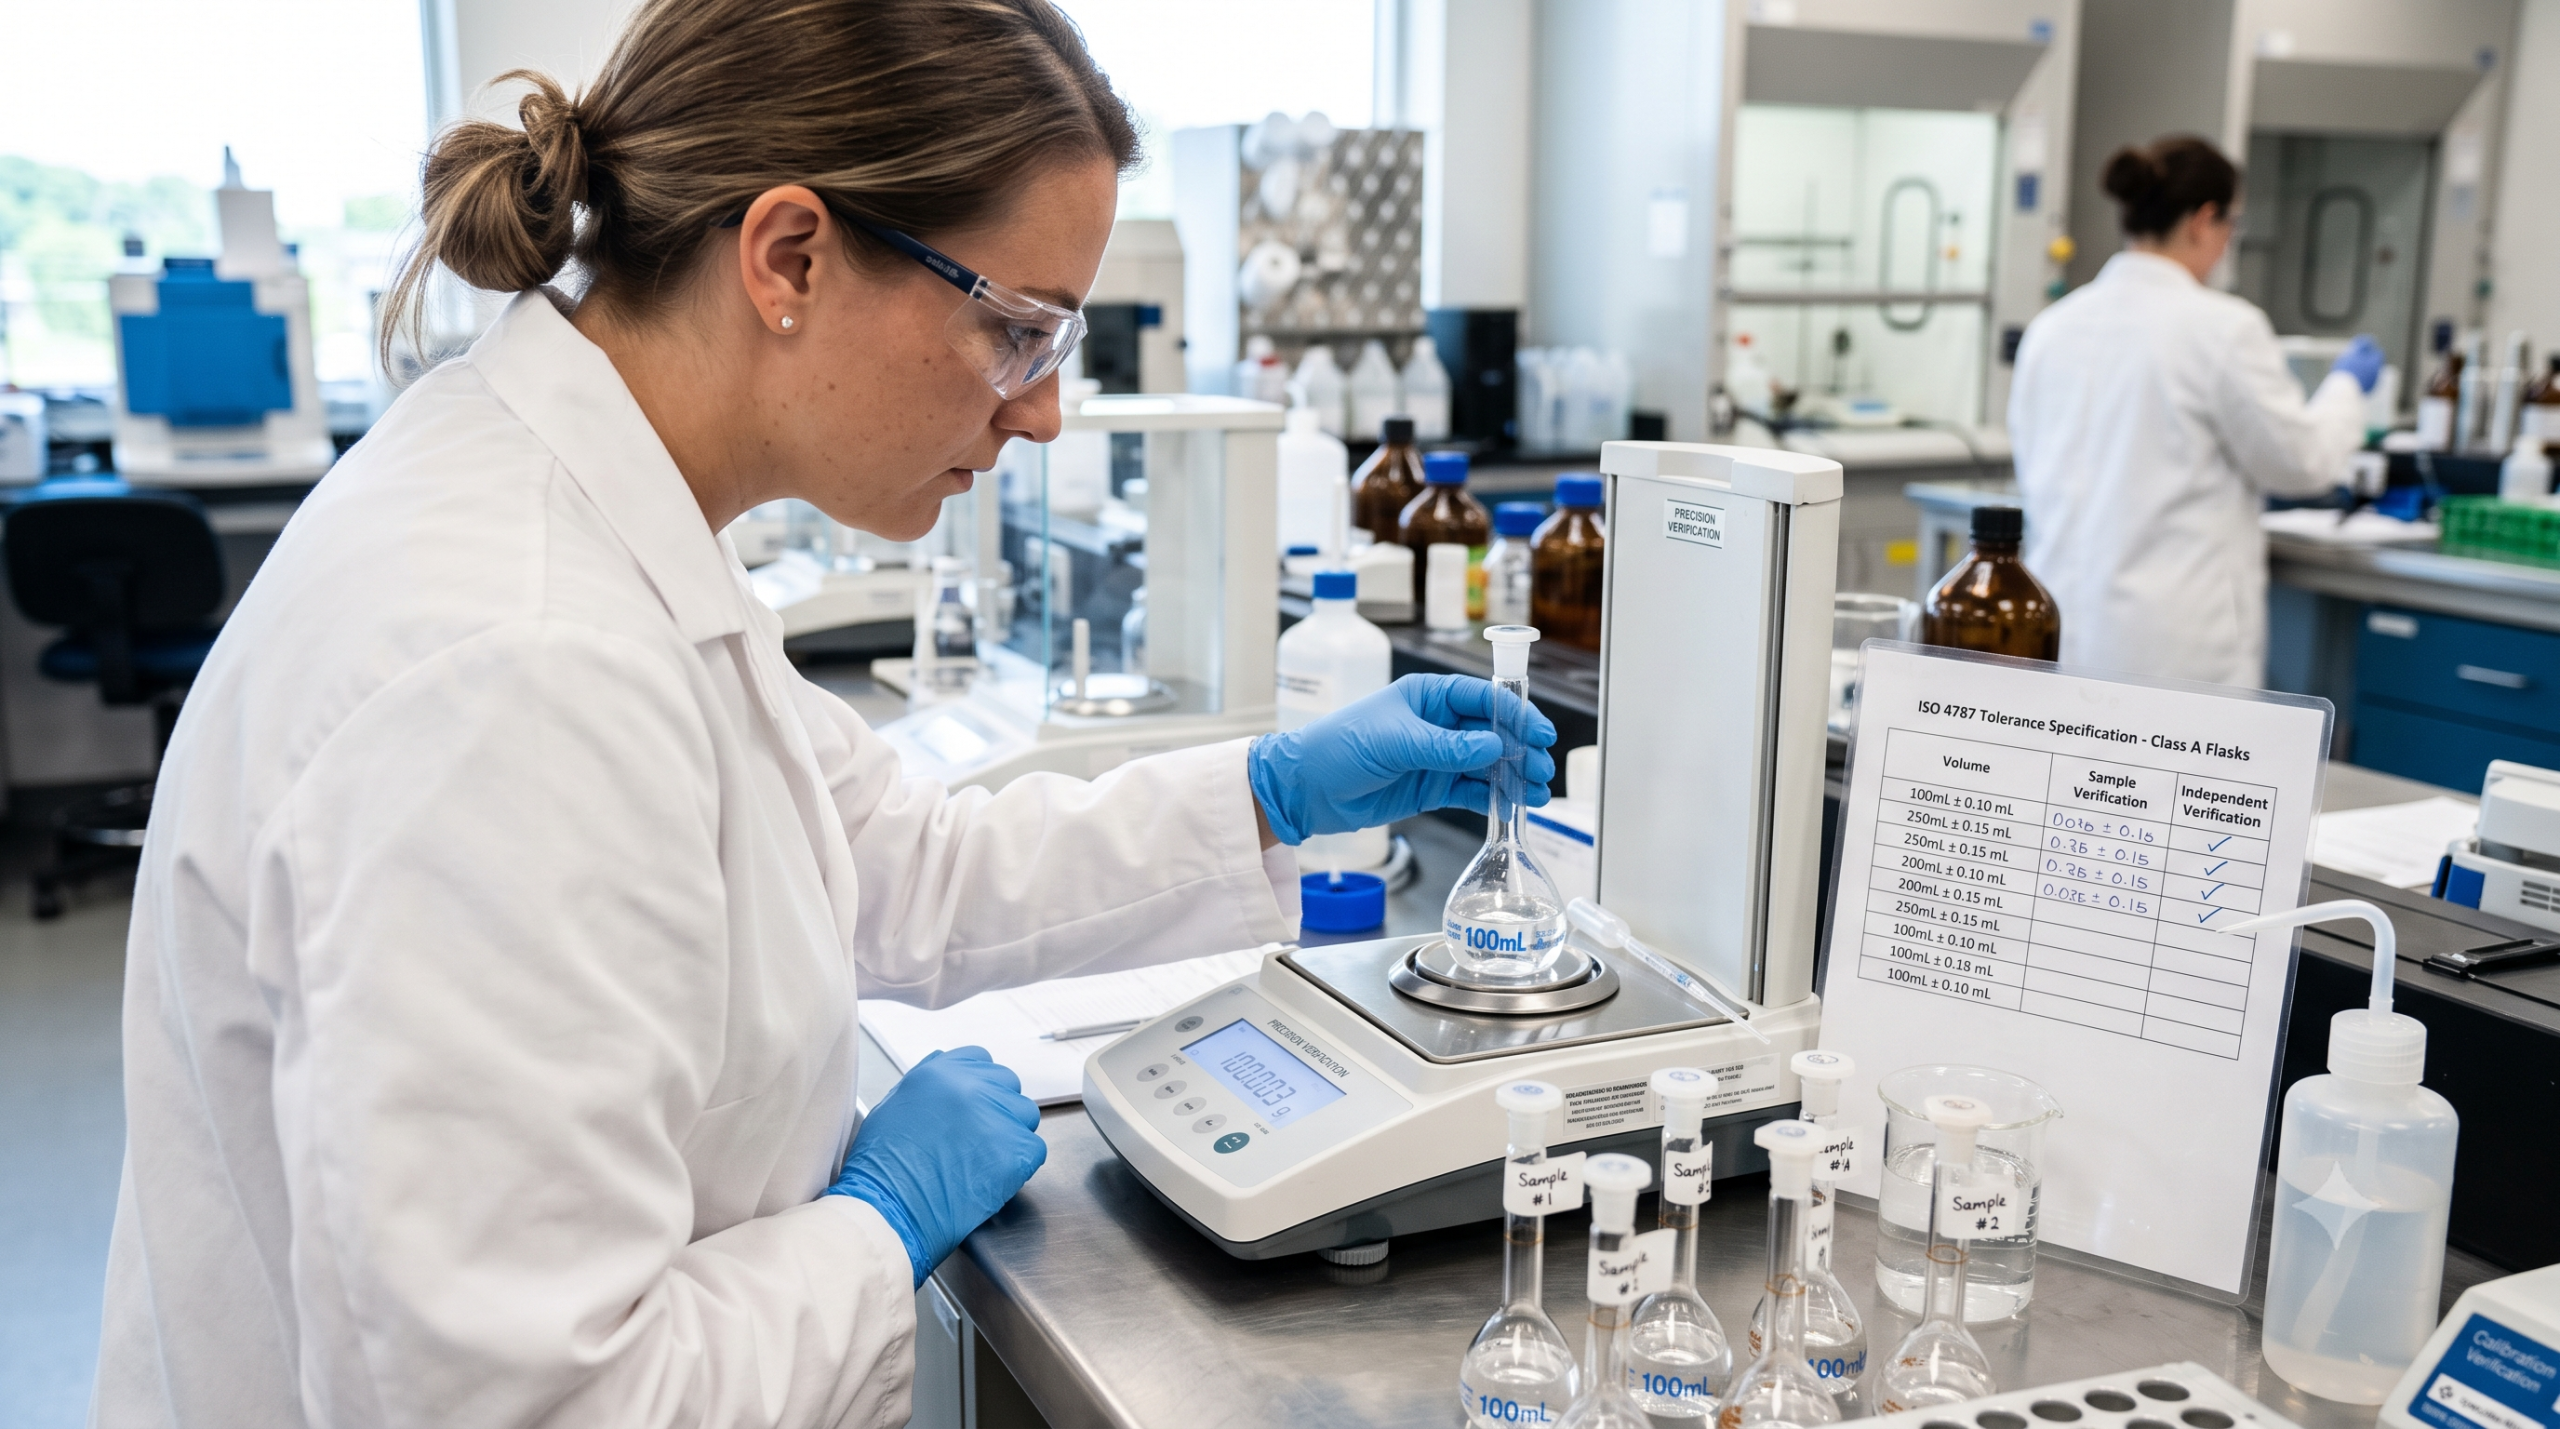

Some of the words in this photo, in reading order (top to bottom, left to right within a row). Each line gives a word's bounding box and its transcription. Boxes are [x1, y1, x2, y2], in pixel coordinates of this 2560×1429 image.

[1674, 508, 1716, 524] PRECISION
[1918, 700, 1941, 715] ISO
[1944, 704, 1976, 720] 4787
[1979, 709, 2045, 730] Tolerance
[2048, 720, 2138, 744] Specification
[2151, 734, 2187, 752] Class
[2191, 741, 2202, 754] A
[2206, 742, 2250, 761] Flasks
[1943, 755, 1990, 774] Volume
[2088, 770, 2136, 788] Sample
[1910, 788, 1950, 806] 100mL
[1953, 796, 1962, 806] ±
[1964, 796, 1992, 812] 0.10
[1994, 803, 2014, 816] mL
[2074, 786, 2148, 809] Verification
[2181, 785, 2268, 810] Independent
[1906, 810, 1948, 829] 250mL
[1950, 818, 1959, 830] ±
[1962, 820, 1989, 835] 0.15
[1992, 826, 2012, 839] mL
[2102, 823, 2112, 834] ±
[2183, 804, 2262, 828] Verification
[1904, 832, 1945, 852] 250mL
[1948, 842, 1956, 853] ±
[1959, 842, 1986, 858] 0.15
[1990, 849, 2009, 862] mL
[2097, 846, 2106, 856] ±
[2114, 848, 2149, 866] 0.15
[1901, 856, 1942, 874] 200mL
[1945, 864, 1954, 876] ±
[1956, 866, 1984, 881] 0.10
[1987, 872, 2006, 886] mL
[2094, 870, 2104, 880] ±
[2112, 872, 2148, 890] 0.15
[1898, 878, 1939, 897] 200mL
[1942, 887, 1950, 898] ±
[1953, 888, 1980, 904] 0.15
[1984, 895, 2004, 908] mL
[2091, 893, 2100, 903] ±
[2108, 896, 2148, 914] 0.15
[1895, 900, 1936, 920] 250mL
[1939, 910, 1948, 921] ±
[1950, 911, 1978, 926] 0.15
[1981, 918, 2000, 932] mL
[1465, 926, 1526, 952] 100mL
[1893, 923, 1934, 942] 100mL
[1936, 932, 1944, 944] ±
[1947, 934, 1975, 950] 0.10
[1978, 940, 1997, 954] mL
[1890, 946, 1930, 964] 100mL
[1933, 955, 1942, 966] ±
[1944, 956, 1971, 972] 0.18
[1974, 963, 1994, 976] mL
[1887, 968, 1928, 986] 100mL
[1930, 978, 1939, 988] ±
[1941, 979, 1969, 994] 0.10
[1972, 986, 1991, 999] mL
[1220, 1052, 1296, 1106] 100.003
[1272, 1106, 1290, 1118] g
[1819, 1136, 1854, 1157] ample
[1518, 1167, 1568, 1190] Sample
[1532, 1192, 1552, 1206] #1
[1952, 1193, 2006, 1214] Sample
[1976, 1216, 1999, 1230] #2
[2472, 1330, 2557, 1380] Calibration
[2466, 1346, 2542, 1394] Verification
[1642, 1372, 1713, 1398] 100mL
[1480, 1395, 1551, 1423] 100mL
